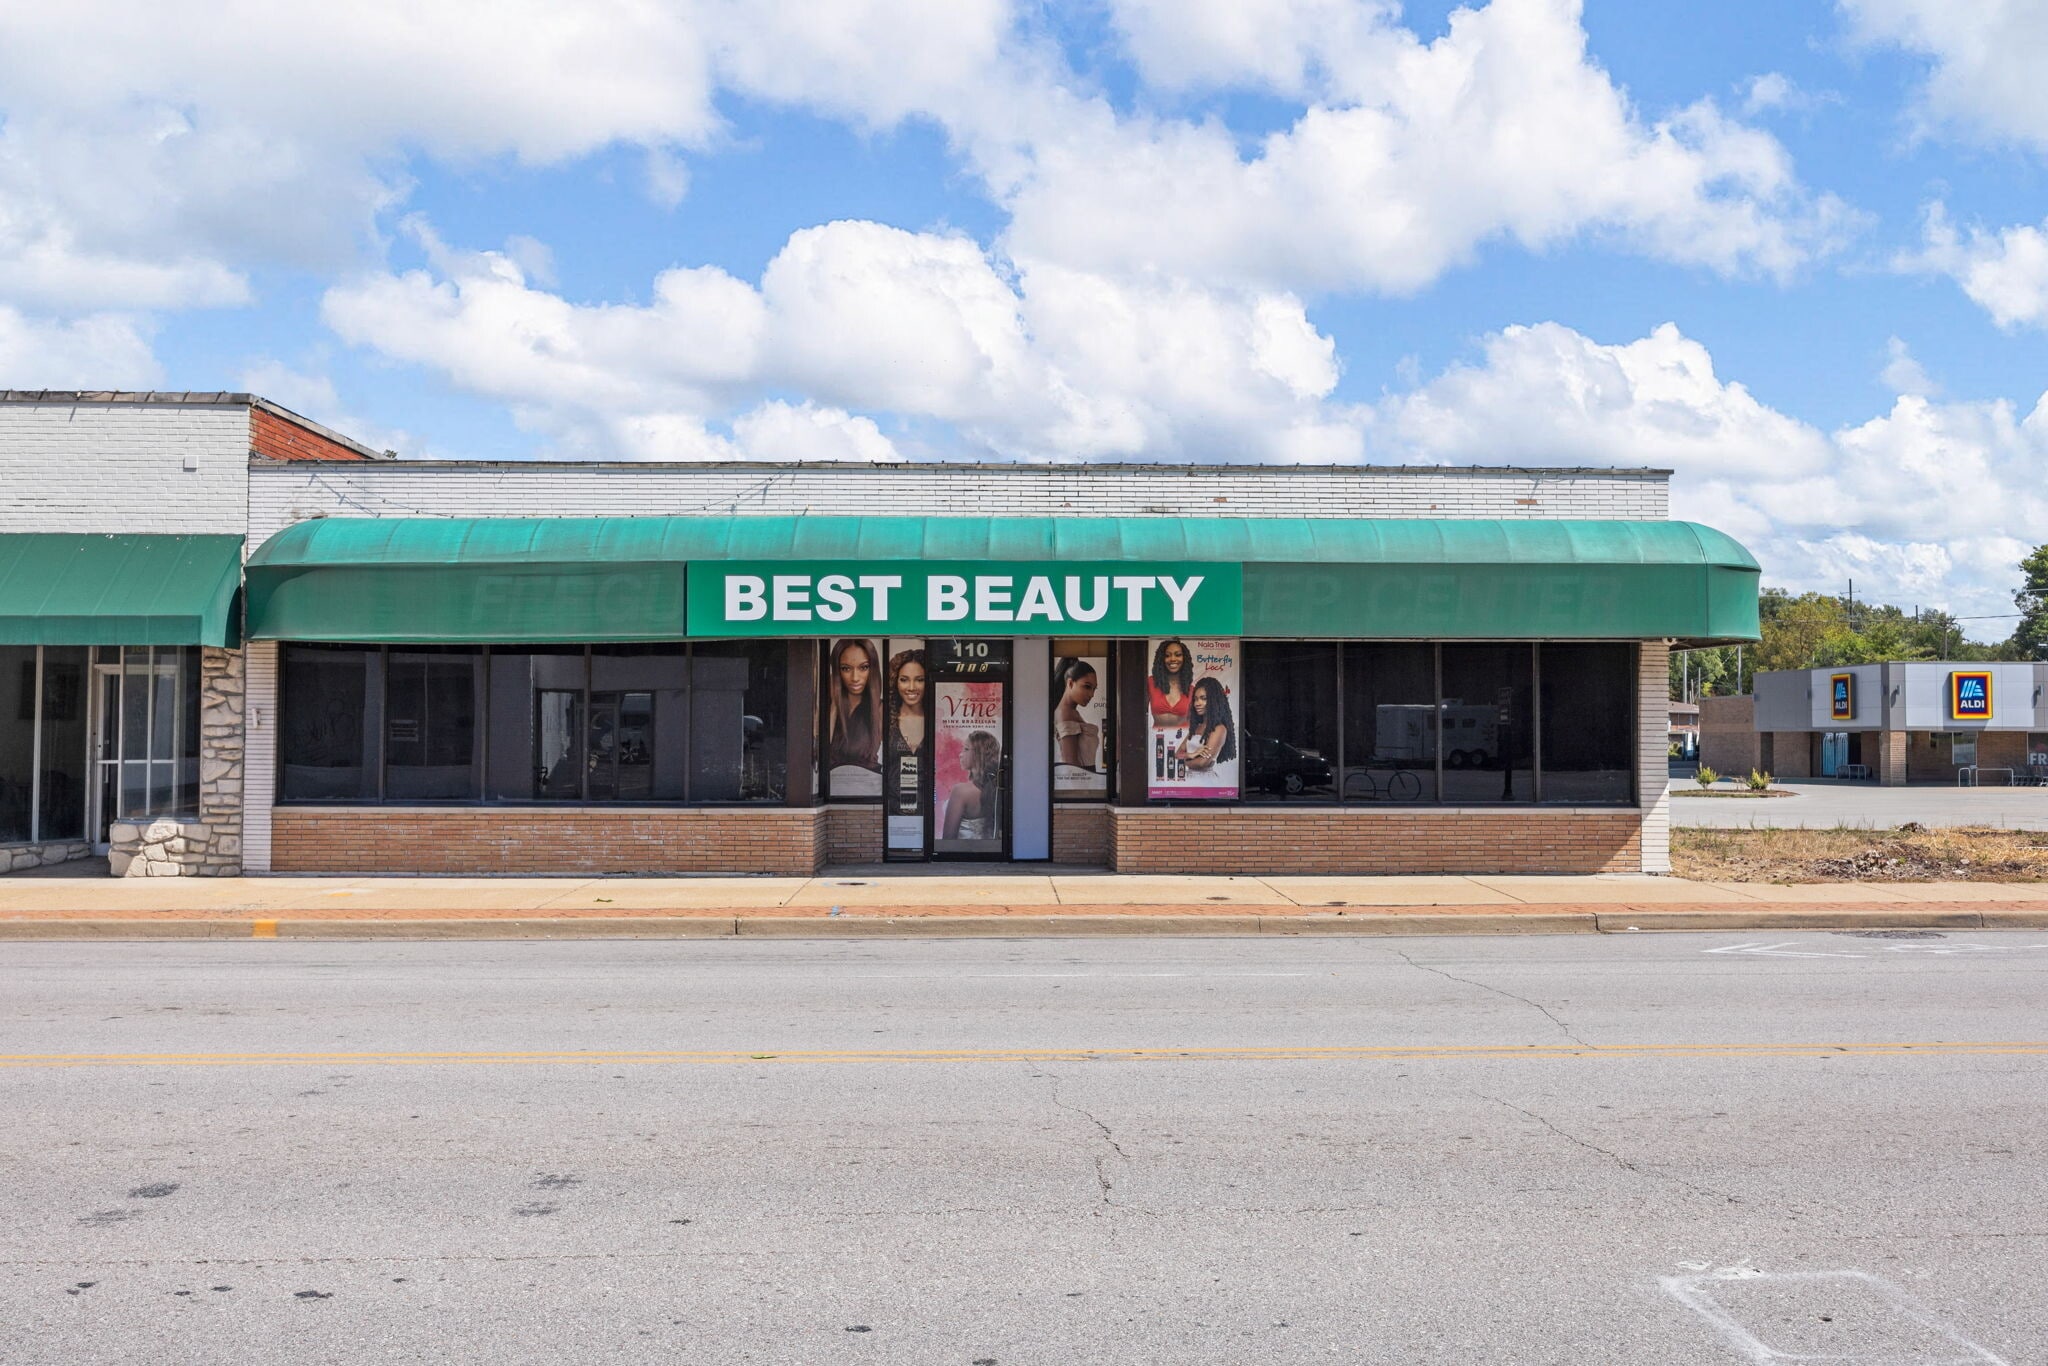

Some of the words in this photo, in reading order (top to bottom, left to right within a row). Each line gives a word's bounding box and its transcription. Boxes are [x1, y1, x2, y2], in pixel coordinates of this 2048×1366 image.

[725, 575, 902, 621] BEST
[927, 575, 1206, 622] BEAUTY
[953, 642, 988, 657] 110
[955, 663, 989, 673] 110
[1196, 654, 1233, 668] Butterfly
[1205, 663, 1224, 671] Locs
[941, 695, 997, 718] Vine
[1835, 702, 1847, 710] ALDI
[1960, 700, 1985, 709] ALDI
[2029, 752, 2048, 766] FR
